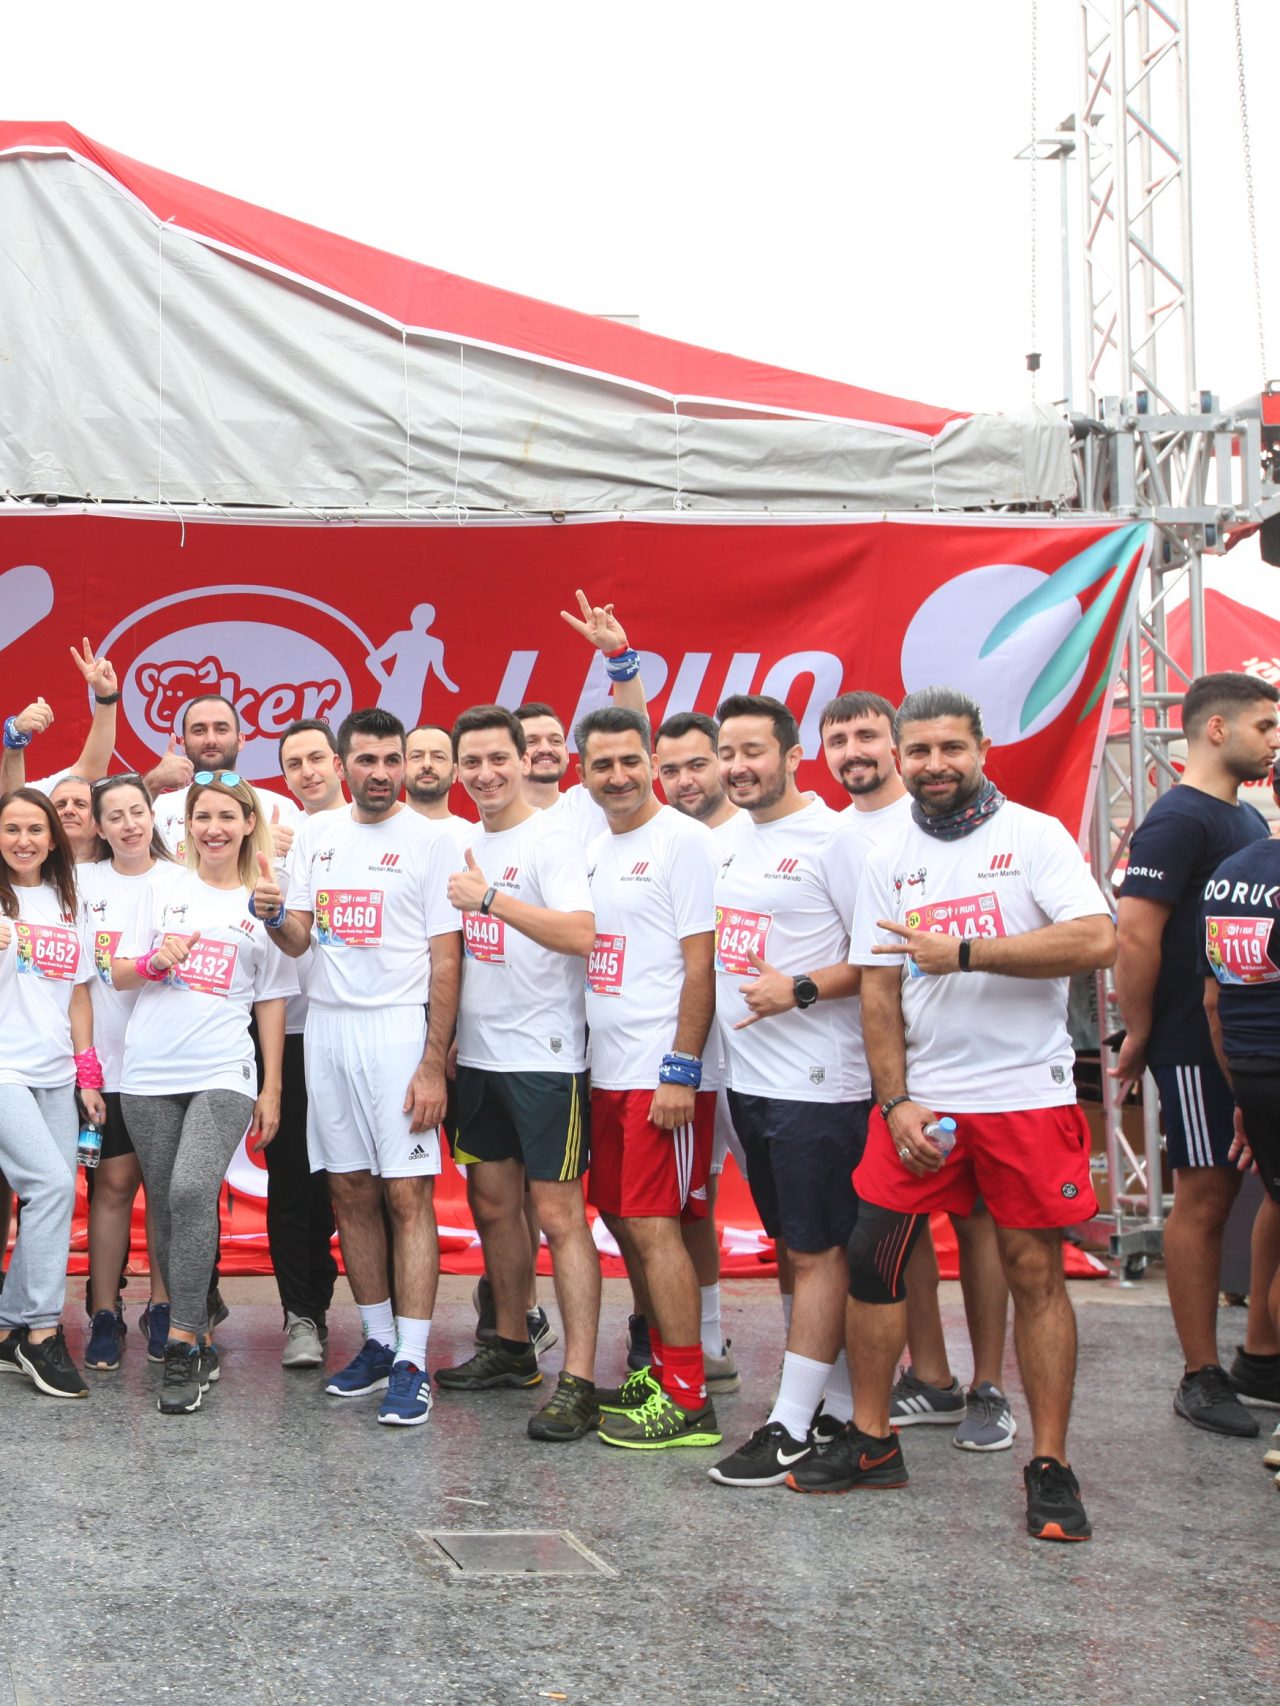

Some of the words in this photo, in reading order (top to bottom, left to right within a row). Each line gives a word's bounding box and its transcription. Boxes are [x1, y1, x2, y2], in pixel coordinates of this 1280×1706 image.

[333, 906, 376, 928] 6460
[466, 919, 499, 945] 6440
[720, 927, 760, 956] 6434
[35, 939, 76, 963] 6452
[588, 951, 618, 976] 6445
[1223, 939, 1262, 964] 7119
[178, 953, 229, 979] 6432
[408, 1153, 430, 1161] adidas
